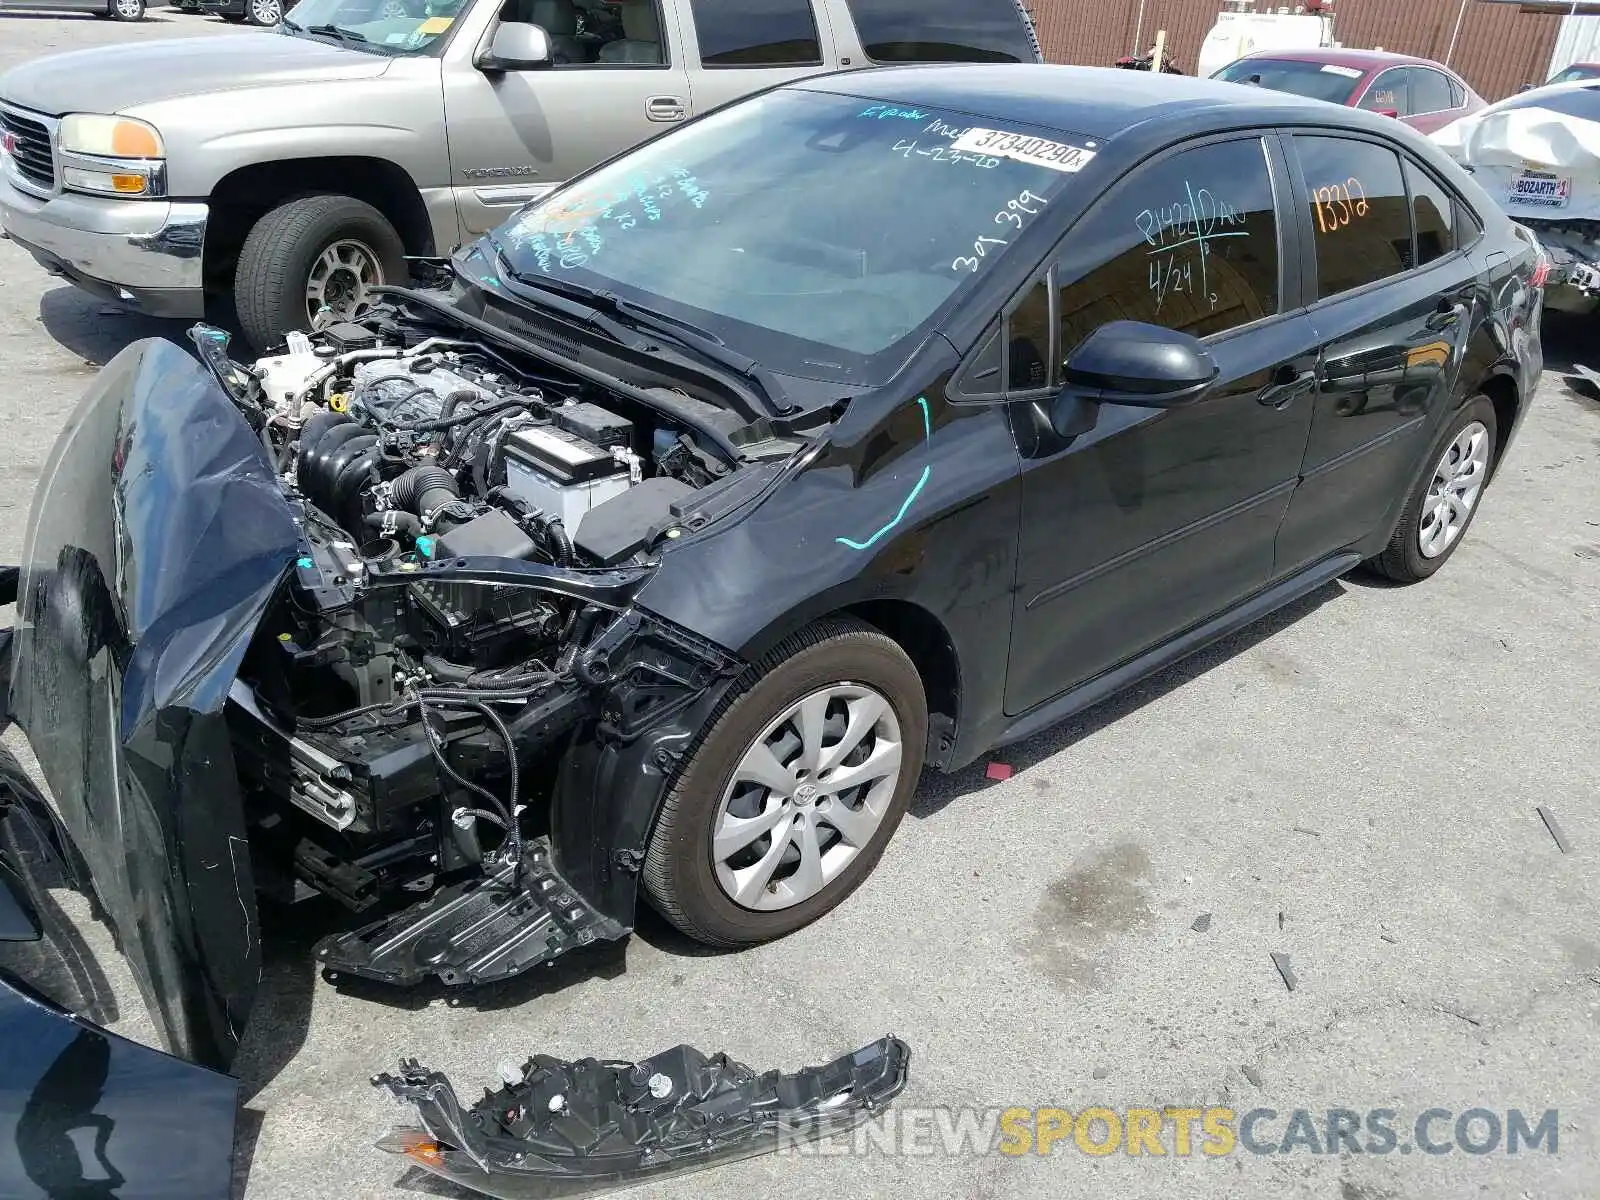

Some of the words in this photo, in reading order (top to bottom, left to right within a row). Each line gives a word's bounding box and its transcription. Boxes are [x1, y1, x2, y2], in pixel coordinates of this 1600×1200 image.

[1312, 177, 1368, 232] 13312
[1517, 180, 1556, 195] BOZARTH
[1148, 252, 1193, 316] 4/24
